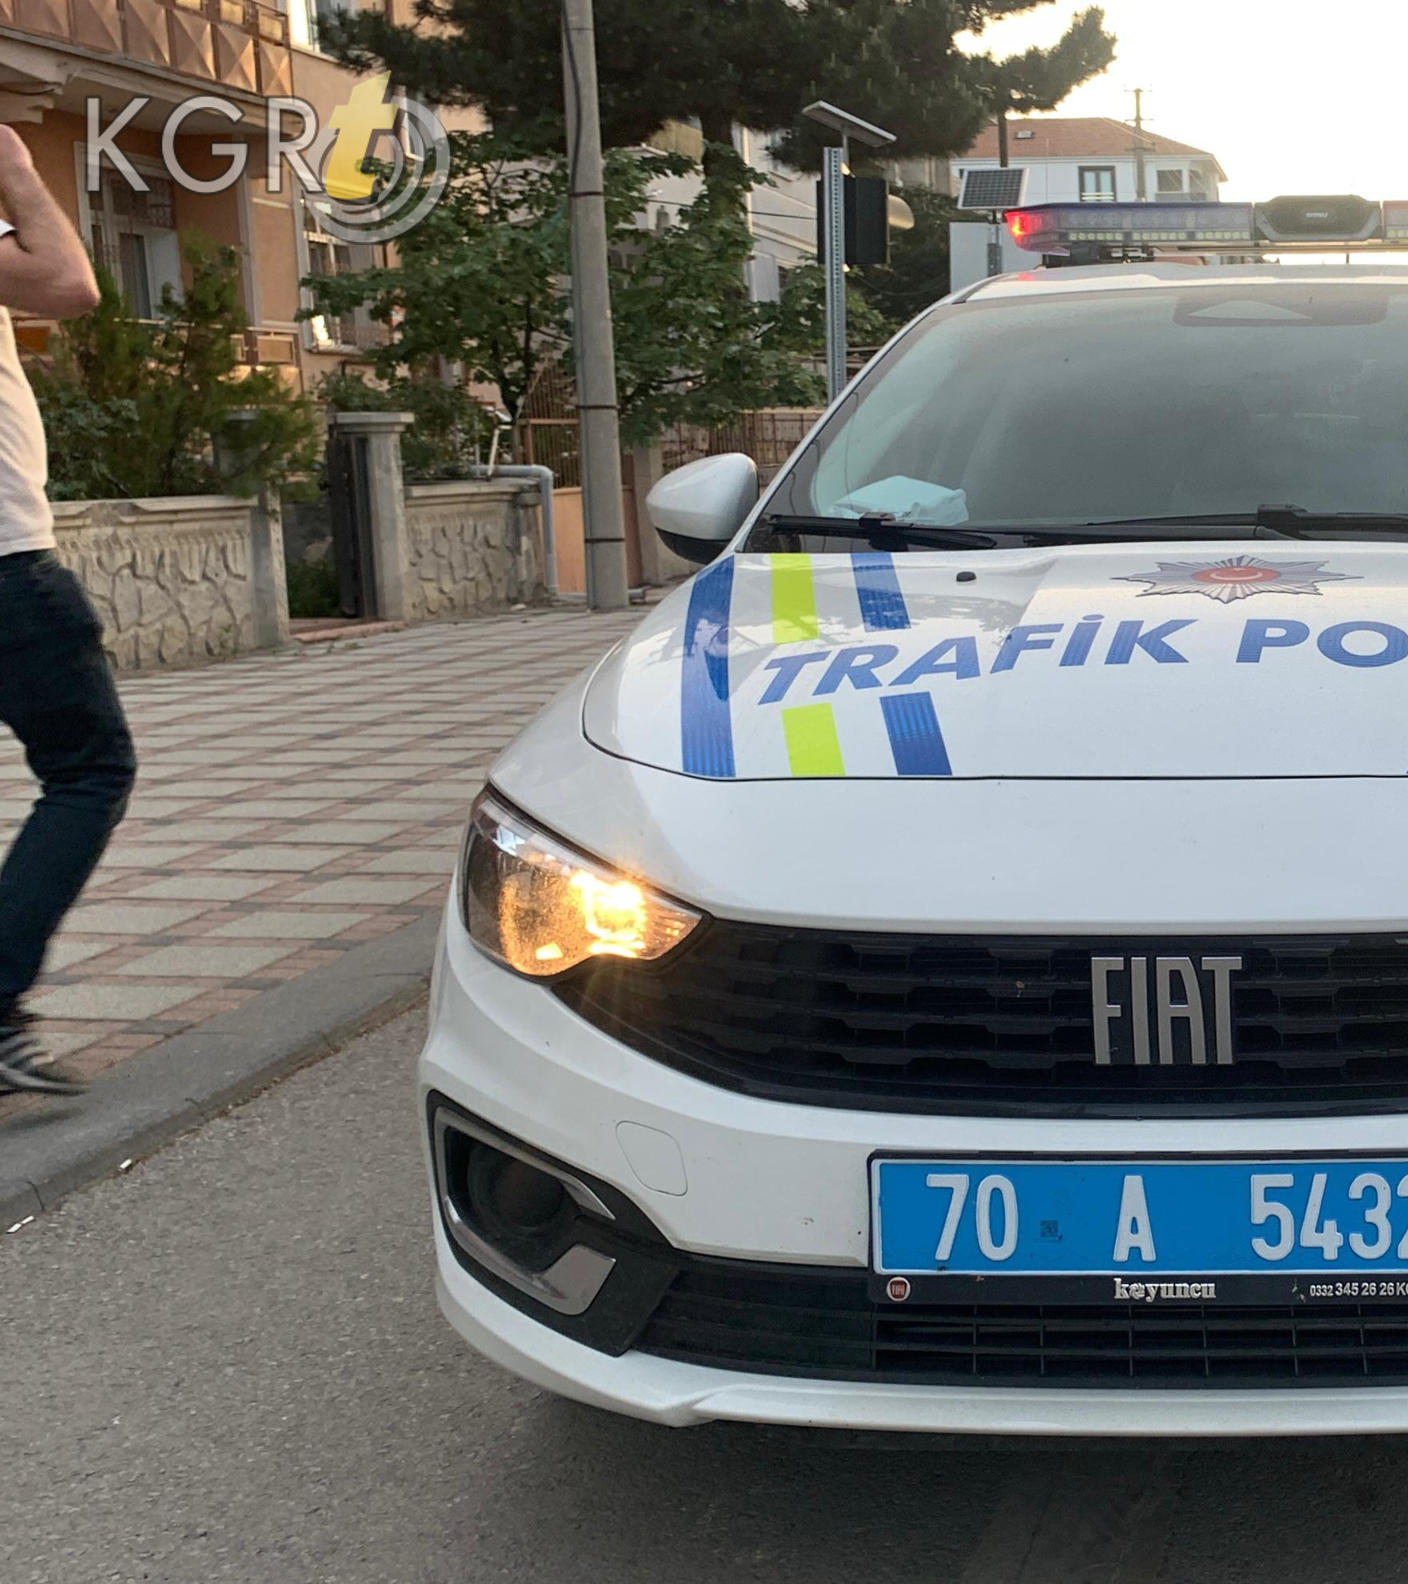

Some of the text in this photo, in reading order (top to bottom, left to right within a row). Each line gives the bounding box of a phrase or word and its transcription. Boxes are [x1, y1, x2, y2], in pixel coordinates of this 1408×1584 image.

[758, 615, 1198, 704] TRAFİK
[1091, 956, 1242, 1065] FIAT
[925, 1172, 1020, 1262] 70
[1113, 1175, 1157, 1262] A
[1113, 1277, 1217, 1303] koyuncu
[1309, 1284, 1334, 1297] 0332
[1335, 1282, 1360, 1296] 345
[1361, 1282, 1377, 1296] 26
[1379, 1282, 1395, 1296] 26
